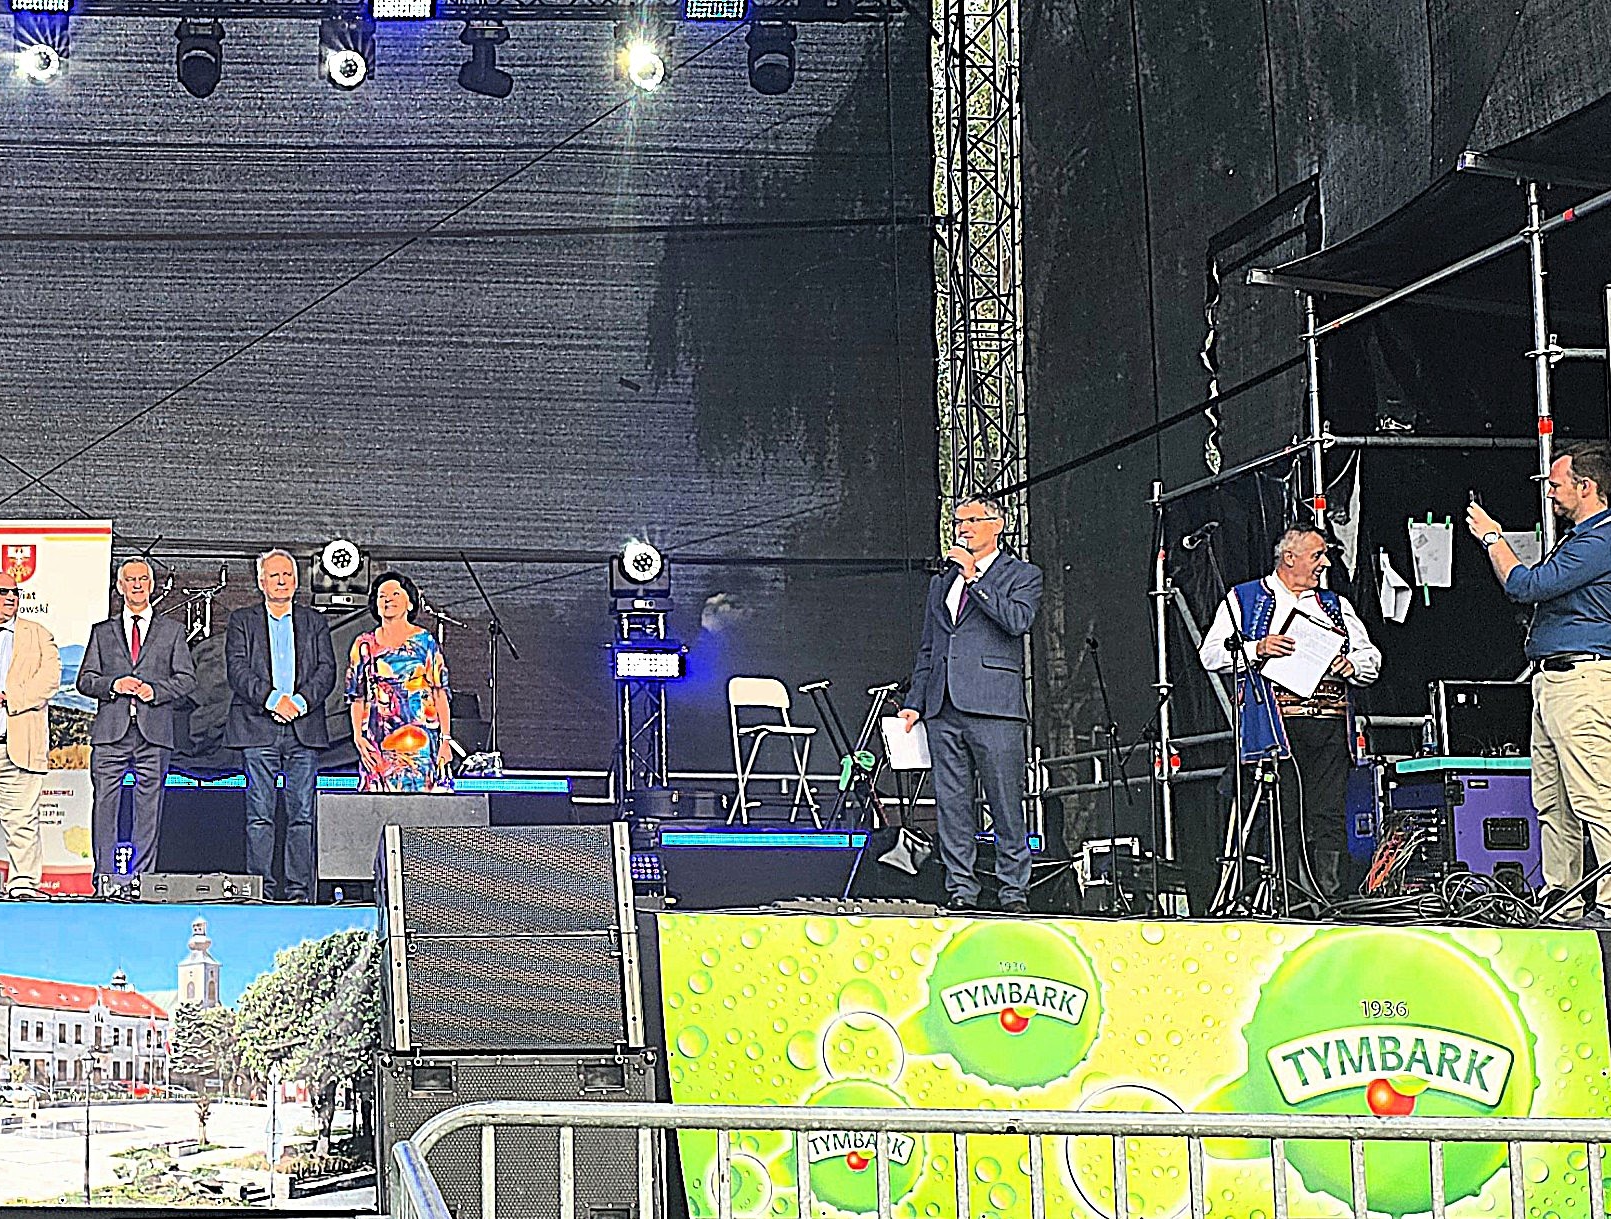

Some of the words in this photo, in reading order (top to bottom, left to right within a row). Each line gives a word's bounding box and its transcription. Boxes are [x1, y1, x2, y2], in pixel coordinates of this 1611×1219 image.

[19, 603, 49, 614] owski
[949, 982, 1077, 1017] TYMBARK
[1361, 1000, 1409, 1018] 1936
[1281, 1035, 1495, 1093] TYMBARK
[808, 1132, 906, 1158] TYMBAK
